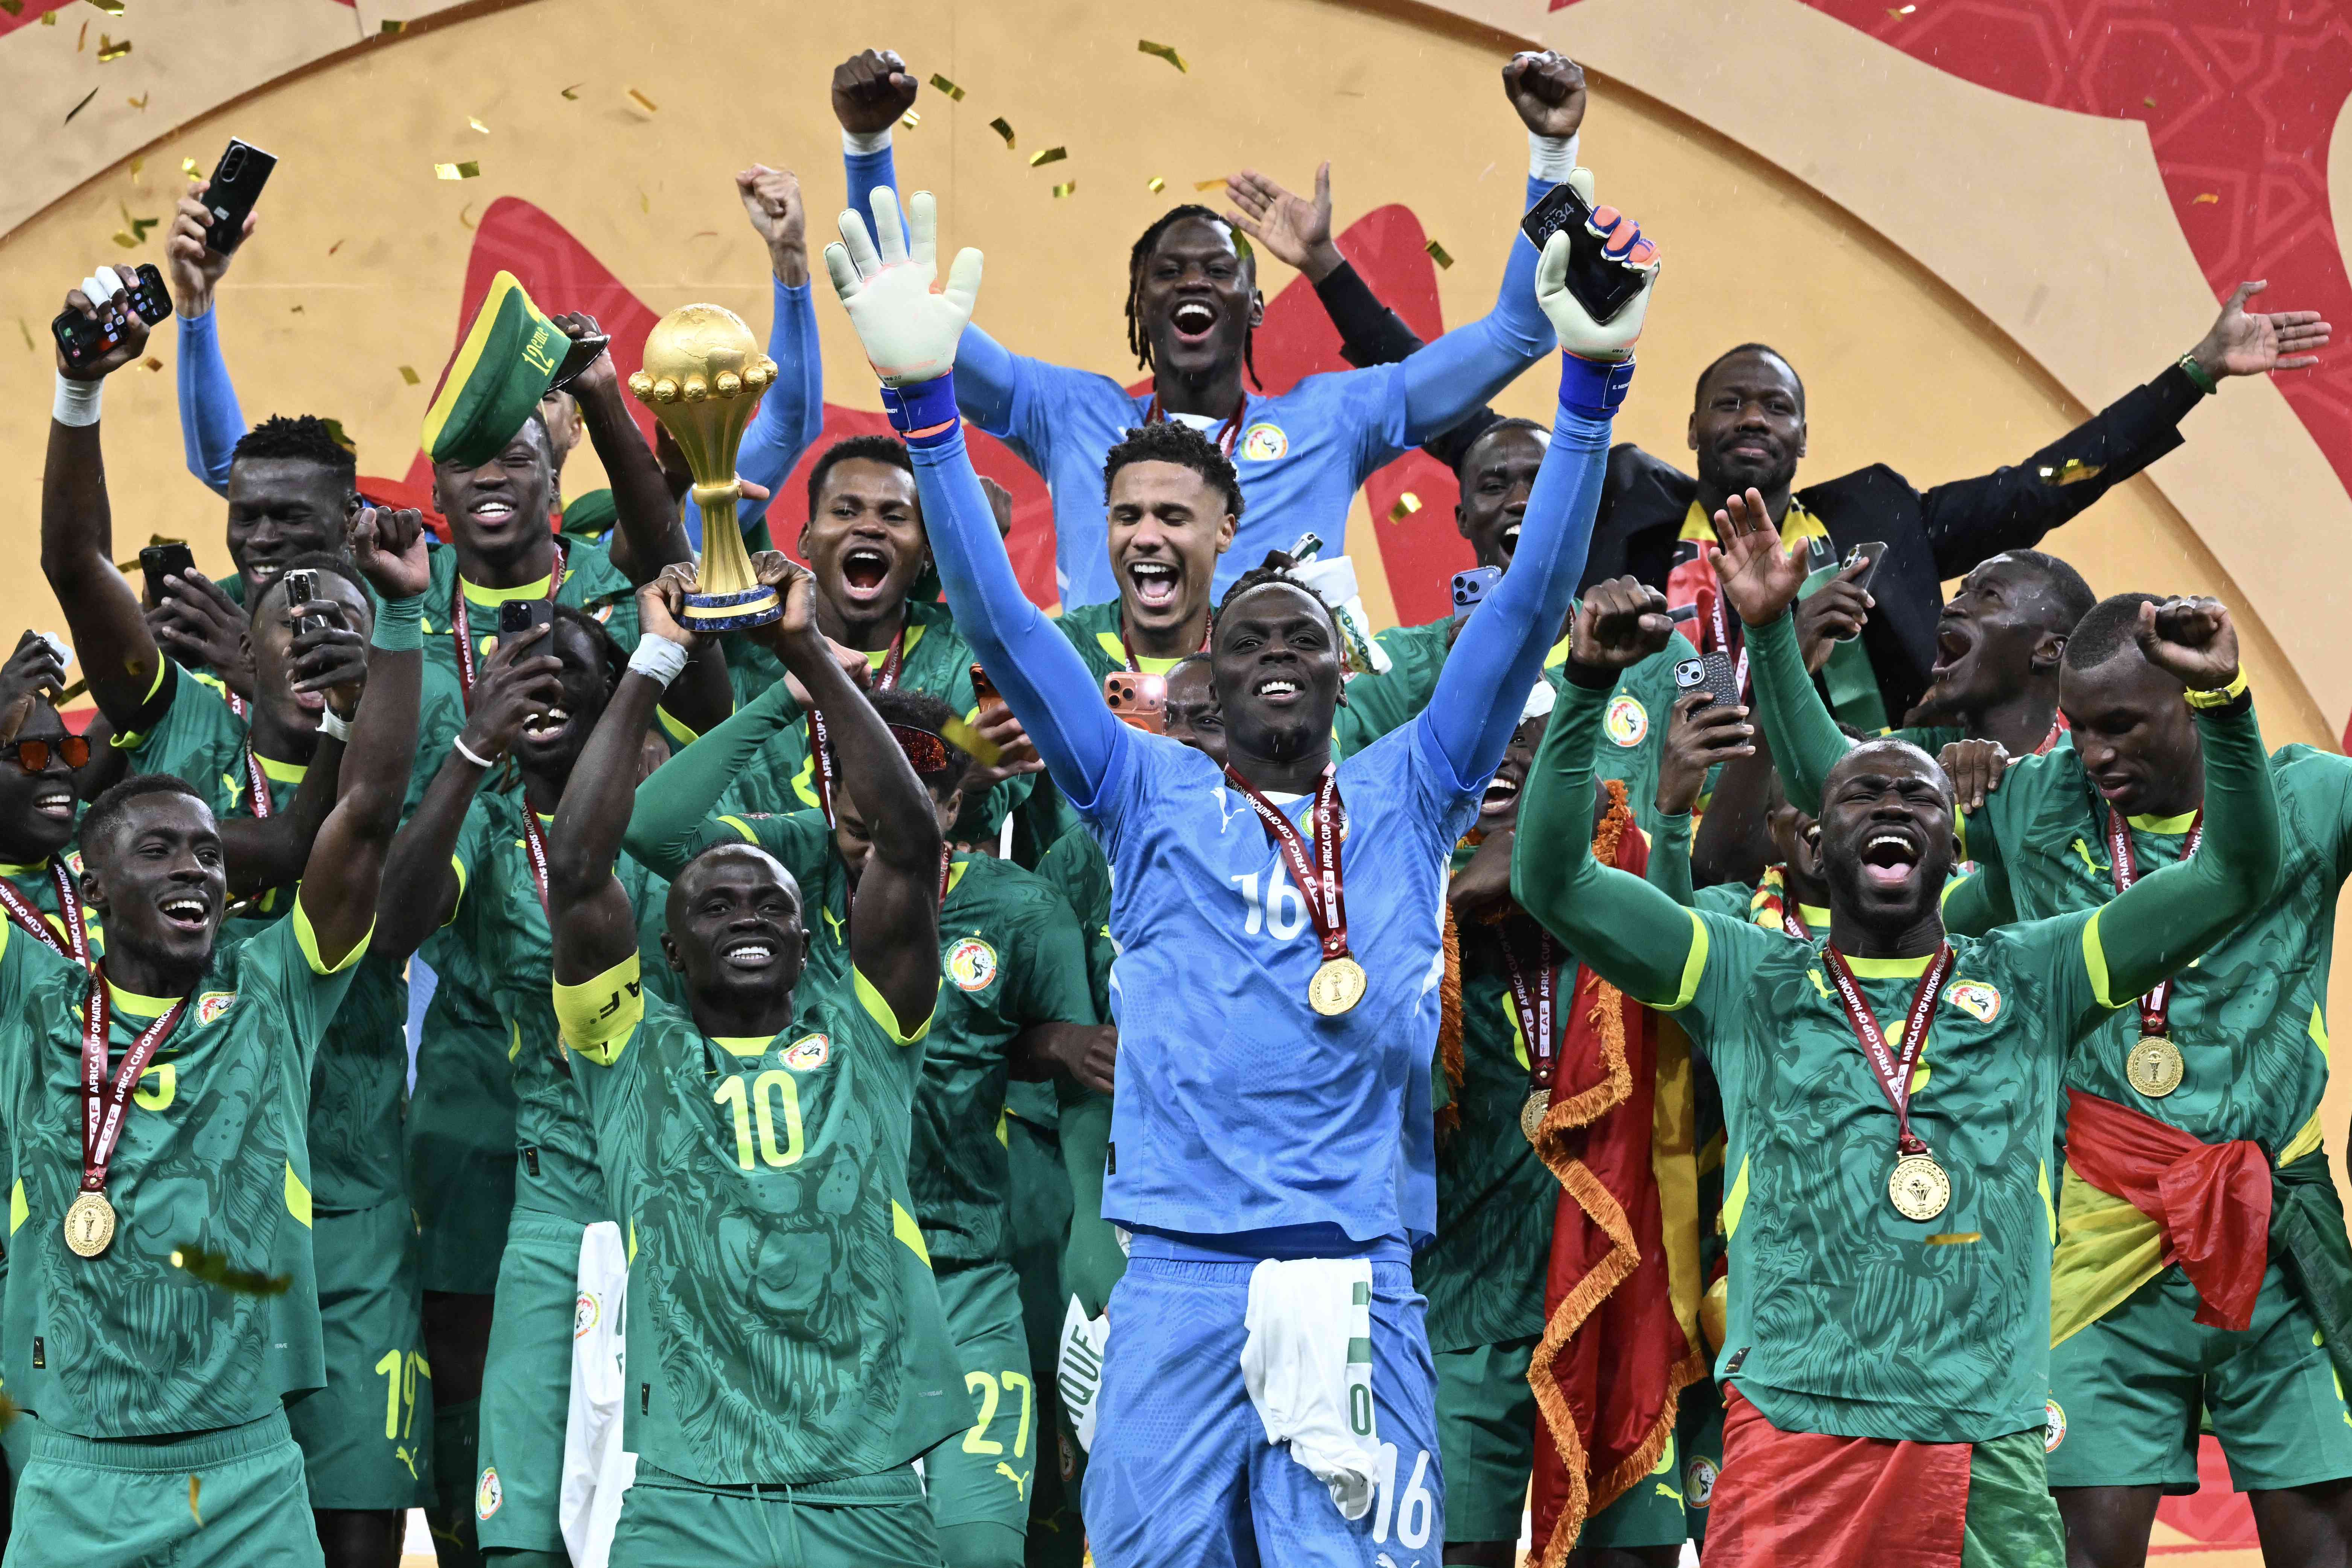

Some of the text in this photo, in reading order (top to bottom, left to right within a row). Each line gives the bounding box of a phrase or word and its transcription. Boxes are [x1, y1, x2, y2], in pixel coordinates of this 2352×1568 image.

[1538, 202, 1574, 240] 23:34
[1245, 793, 1274, 819] NATIONS
[1268, 815, 1282, 825] OF
[1276, 823, 1294, 839] CUP
[1320, 776, 1337, 869] AFRICA CUP OF NATIONS
[529, 834, 547, 867] NATIONS
[1288, 839, 1309, 874] AFRICA
[2116, 832, 2130, 876] NATIONS
[64, 893, 74, 904] OF
[1231, 851, 1312, 940] 16
[1325, 875, 1335, 905] CAF
[2122, 877, 2131, 891] OF
[14, 905, 27, 917] OF
[24, 915, 41, 932] CUP
[67, 906, 78, 923] CUP
[70, 923, 83, 955] AFRICA
[1838, 976, 1863, 1012] NATIONS
[1922, 970, 1940, 1003] NATIONS
[1856, 1011, 1869, 1024] OF
[1912, 1013, 1925, 1031] CUP
[1918, 1000, 1928, 1013] OF
[91, 1020, 101, 1033] OF
[1862, 1024, 1878, 1043] CUP
[90, 1034, 100, 1054] CUP
[1871, 1041, 1895, 1076] AFRICA
[1902, 1030, 1920, 1062] AFRICA
[90, 1055, 99, 1094] AFRICA
[114, 1065, 137, 1103] AFRICA
[131, 1046, 145, 1066] CUP
[143, 1034, 154, 1047] OF
[102, 1111, 116, 1142] CAF
[713, 1070, 804, 1171] 10
[1898, 1168, 1940, 1191] AFRICAN CHAMPION
[962, 1370, 1031, 1458] 27
[1373, 1442, 1431, 1549] 16
